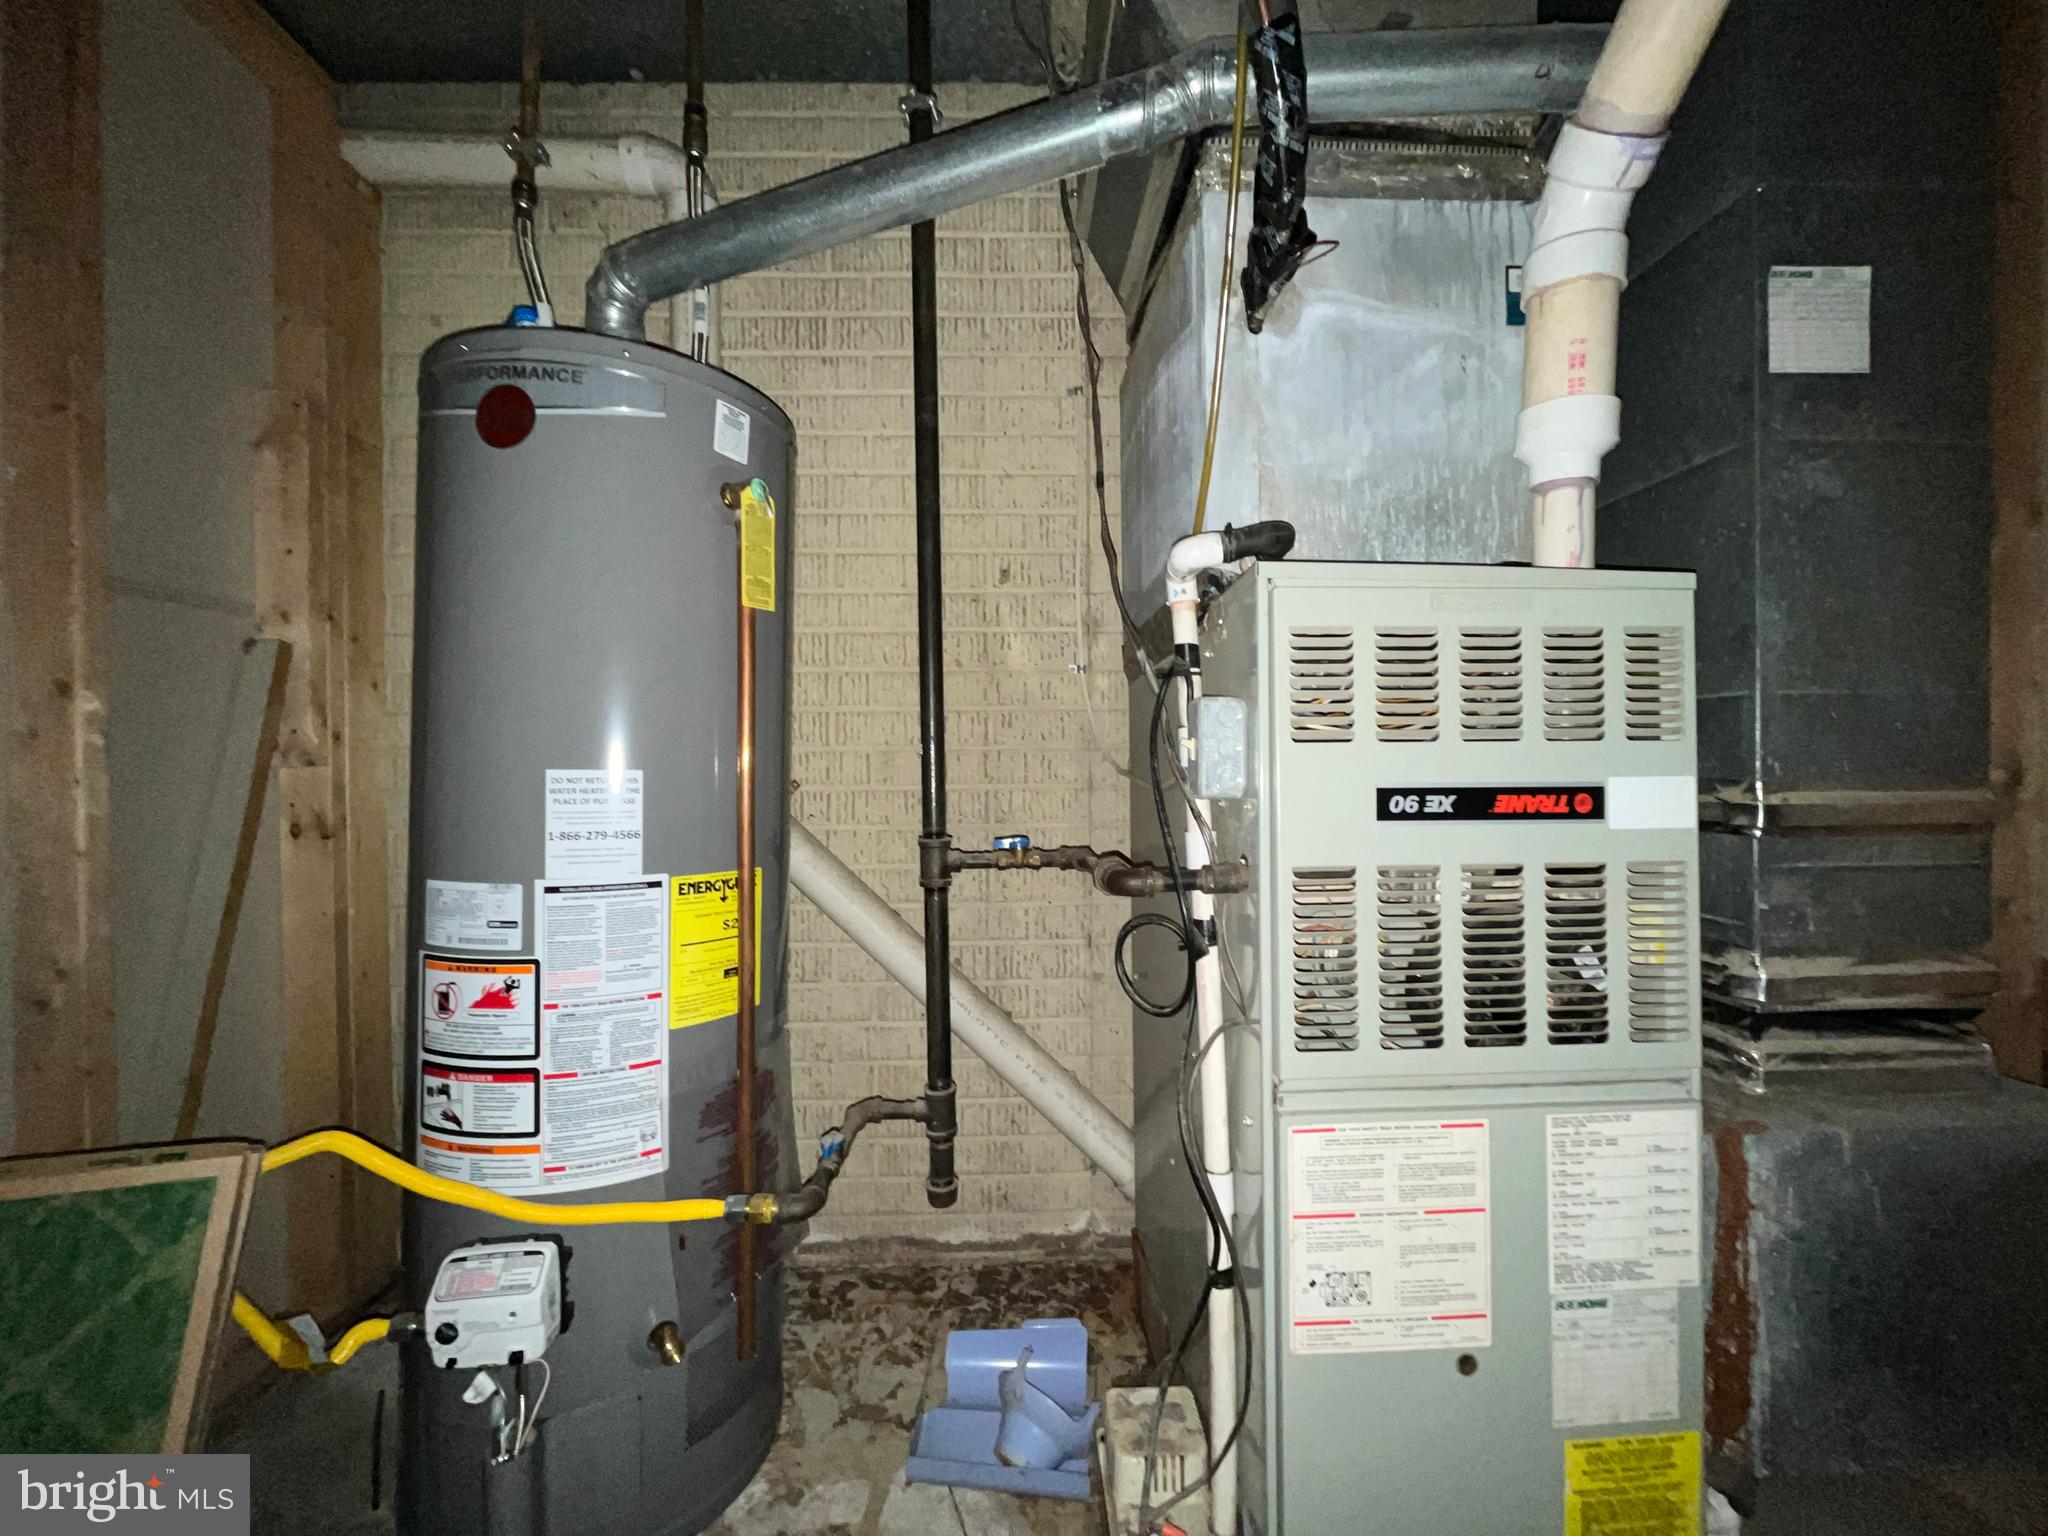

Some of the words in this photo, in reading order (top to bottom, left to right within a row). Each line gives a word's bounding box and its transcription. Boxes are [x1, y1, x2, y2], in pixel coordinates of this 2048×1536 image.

[456, 364, 584, 385] RFORMANCE
[549, 787, 577, 795] WATER
[566, 777, 582, 785] NOT
[553, 798, 578, 806] PLACE
[1389, 794, 1420, 815] 90
[1423, 794, 1458, 814] XE
[1494, 794, 1570, 814] TRANE
[548, 830, 641, 841] 1-866-279-4566
[678, 874, 757, 896] ENERGYG
